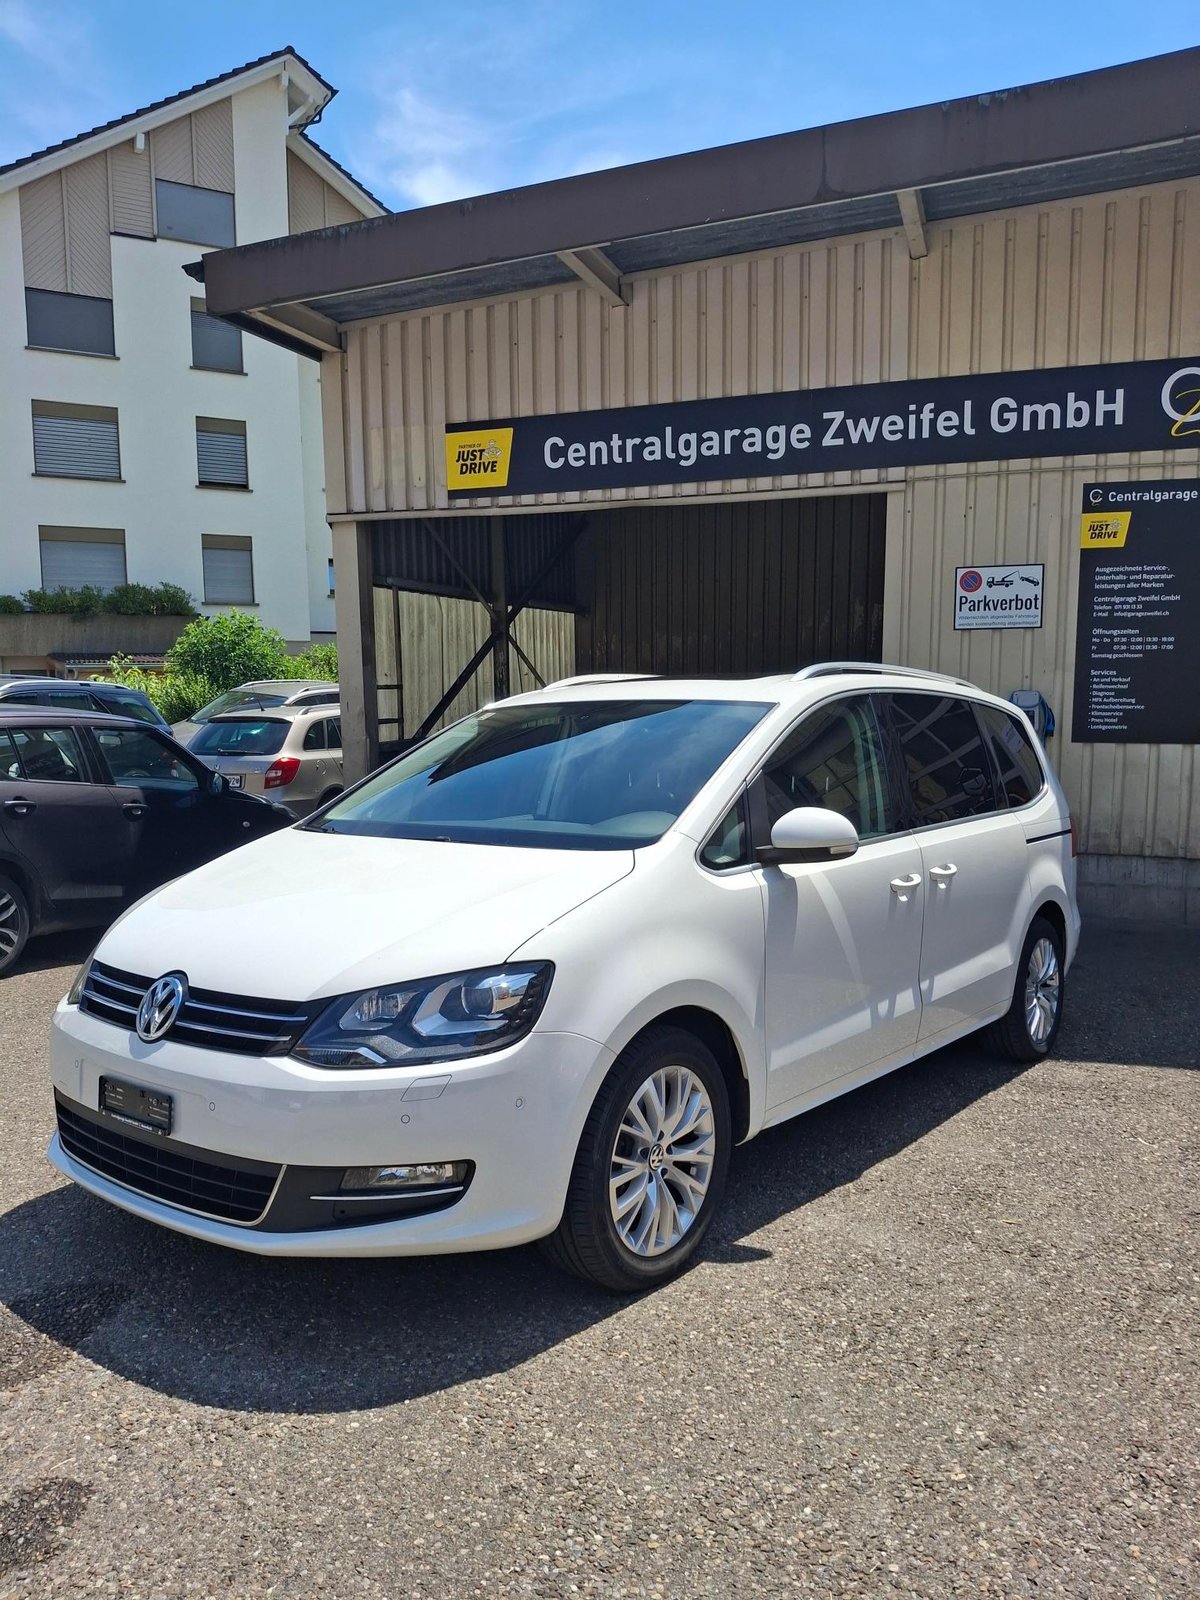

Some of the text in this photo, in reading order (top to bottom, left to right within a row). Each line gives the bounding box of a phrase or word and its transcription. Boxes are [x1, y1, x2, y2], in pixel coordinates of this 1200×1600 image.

[543, 388, 1125, 470] Centralgarage Zweifel GmbH
[456, 448, 486, 463] JUST
[460, 460, 498, 475] DRIVE
[1108, 490, 1198, 503] Centralgarage
[1088, 523, 1110, 532] JUST
[1090, 531, 1118, 540] DRIVE
[959, 594, 1039, 612] Parkverbot
